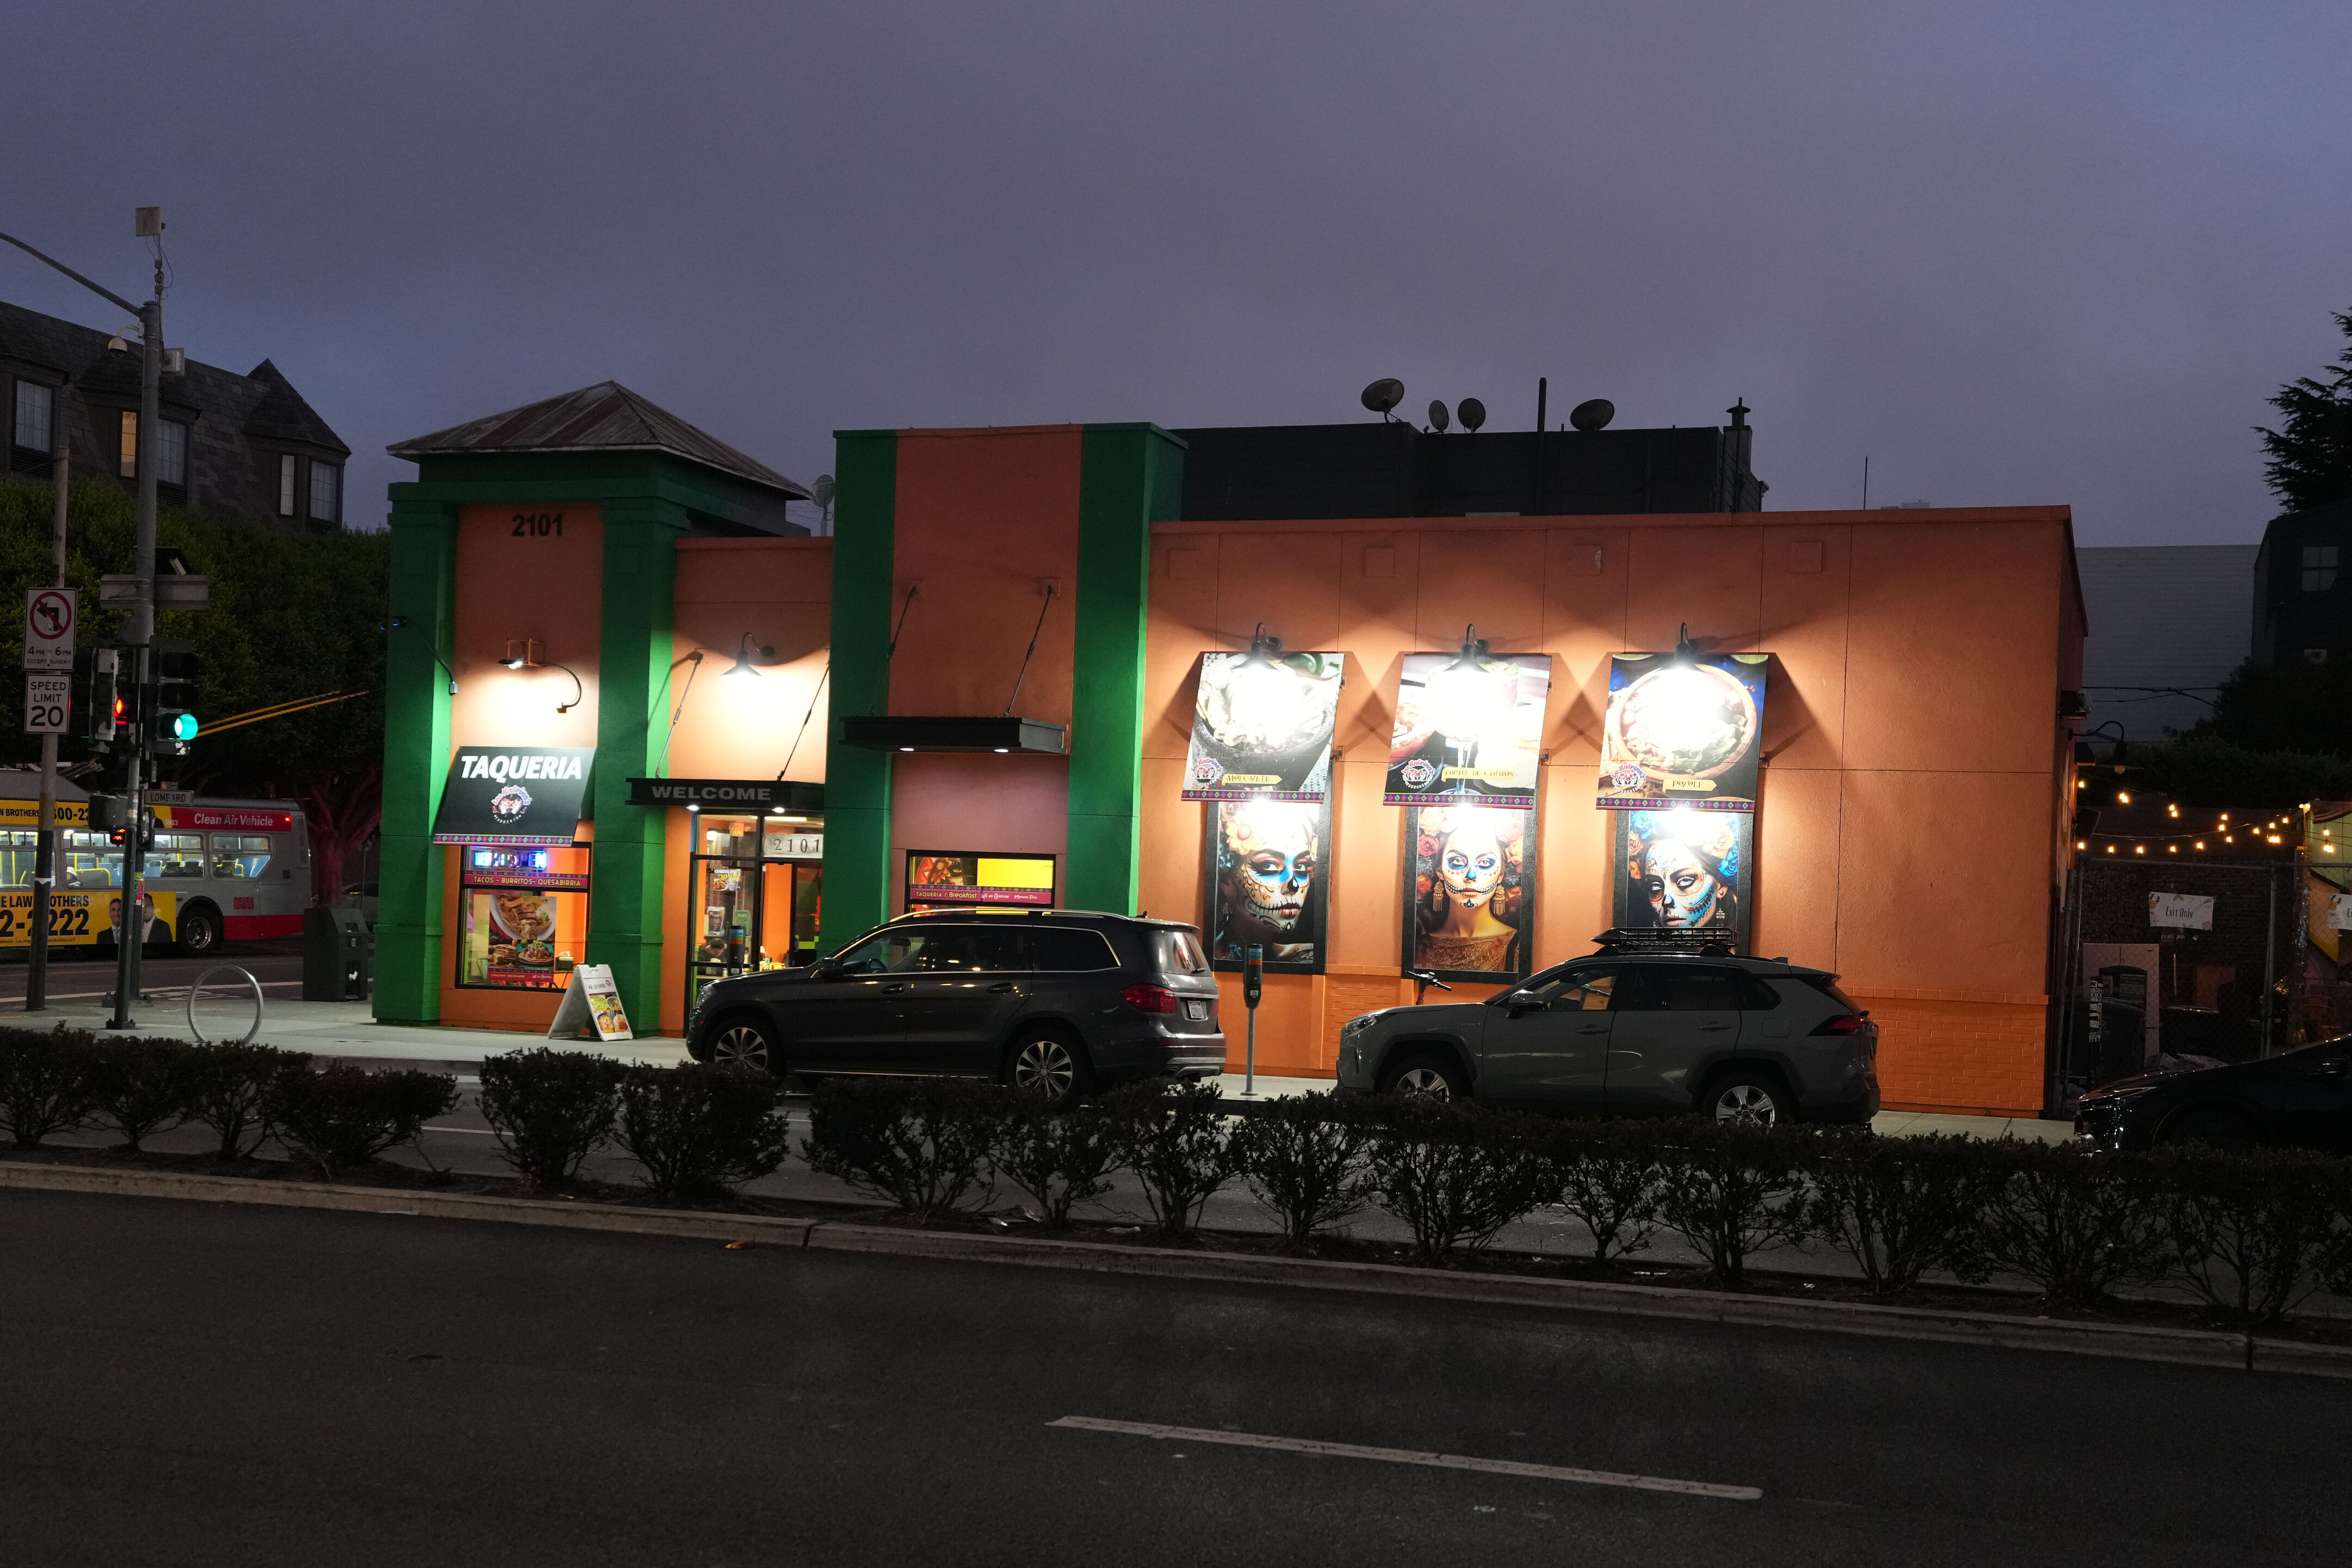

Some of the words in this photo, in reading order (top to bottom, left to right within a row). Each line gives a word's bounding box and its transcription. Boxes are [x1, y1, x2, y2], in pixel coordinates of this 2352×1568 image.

[512, 513, 562, 536] 2101
[27, 646, 45, 655] 4PM
[55, 646, 71, 656] 6PM
[30, 682, 66, 691] SPEED
[34, 694, 62, 702] LIMIT
[30, 705, 64, 727] 20
[461, 755, 581, 783] TAQUERIA
[1401, 765, 1410, 774] Las
[1610, 770, 1620, 778] Las
[652, 786, 771, 800] WELCOME
[5, 808, 40, 817] BROTHERS
[194, 813, 222, 825] Clean
[224, 814, 238, 825] Air
[240, 815, 273, 826] Vehicle
[773, 838, 820, 853] 2101
[10, 896, 33, 908] LAW
[50, 895, 89, 907] OTHERS
[2166, 906, 2178, 917] Exit
[2179, 908, 2193, 920] Only
